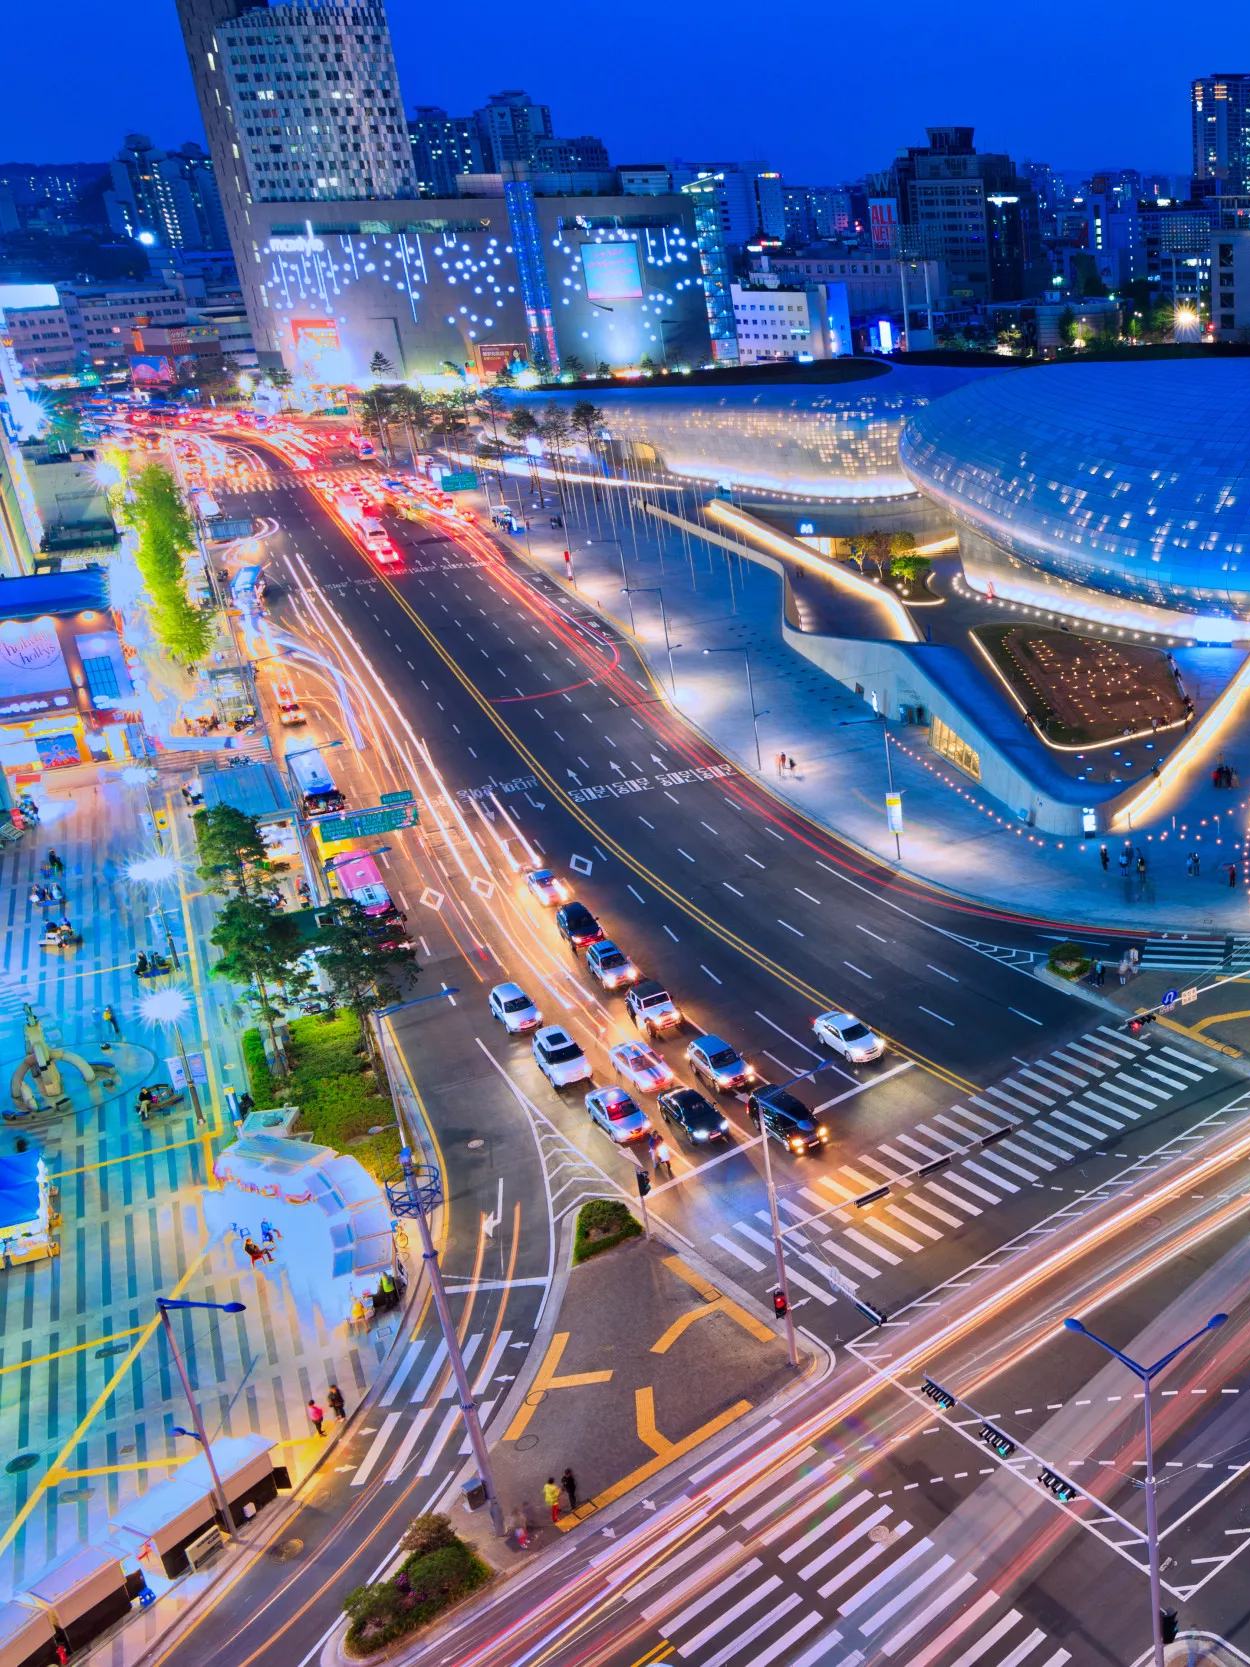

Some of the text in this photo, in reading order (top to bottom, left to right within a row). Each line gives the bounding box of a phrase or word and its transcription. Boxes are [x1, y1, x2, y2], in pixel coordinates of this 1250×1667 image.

[871, 204, 896, 224] ALL
[655, 770, 697, 787] 동대문
[695, 763, 738, 780] 동대문
[567, 785, 609, 803] 동대문
[612, 777, 655, 795] 동대문
